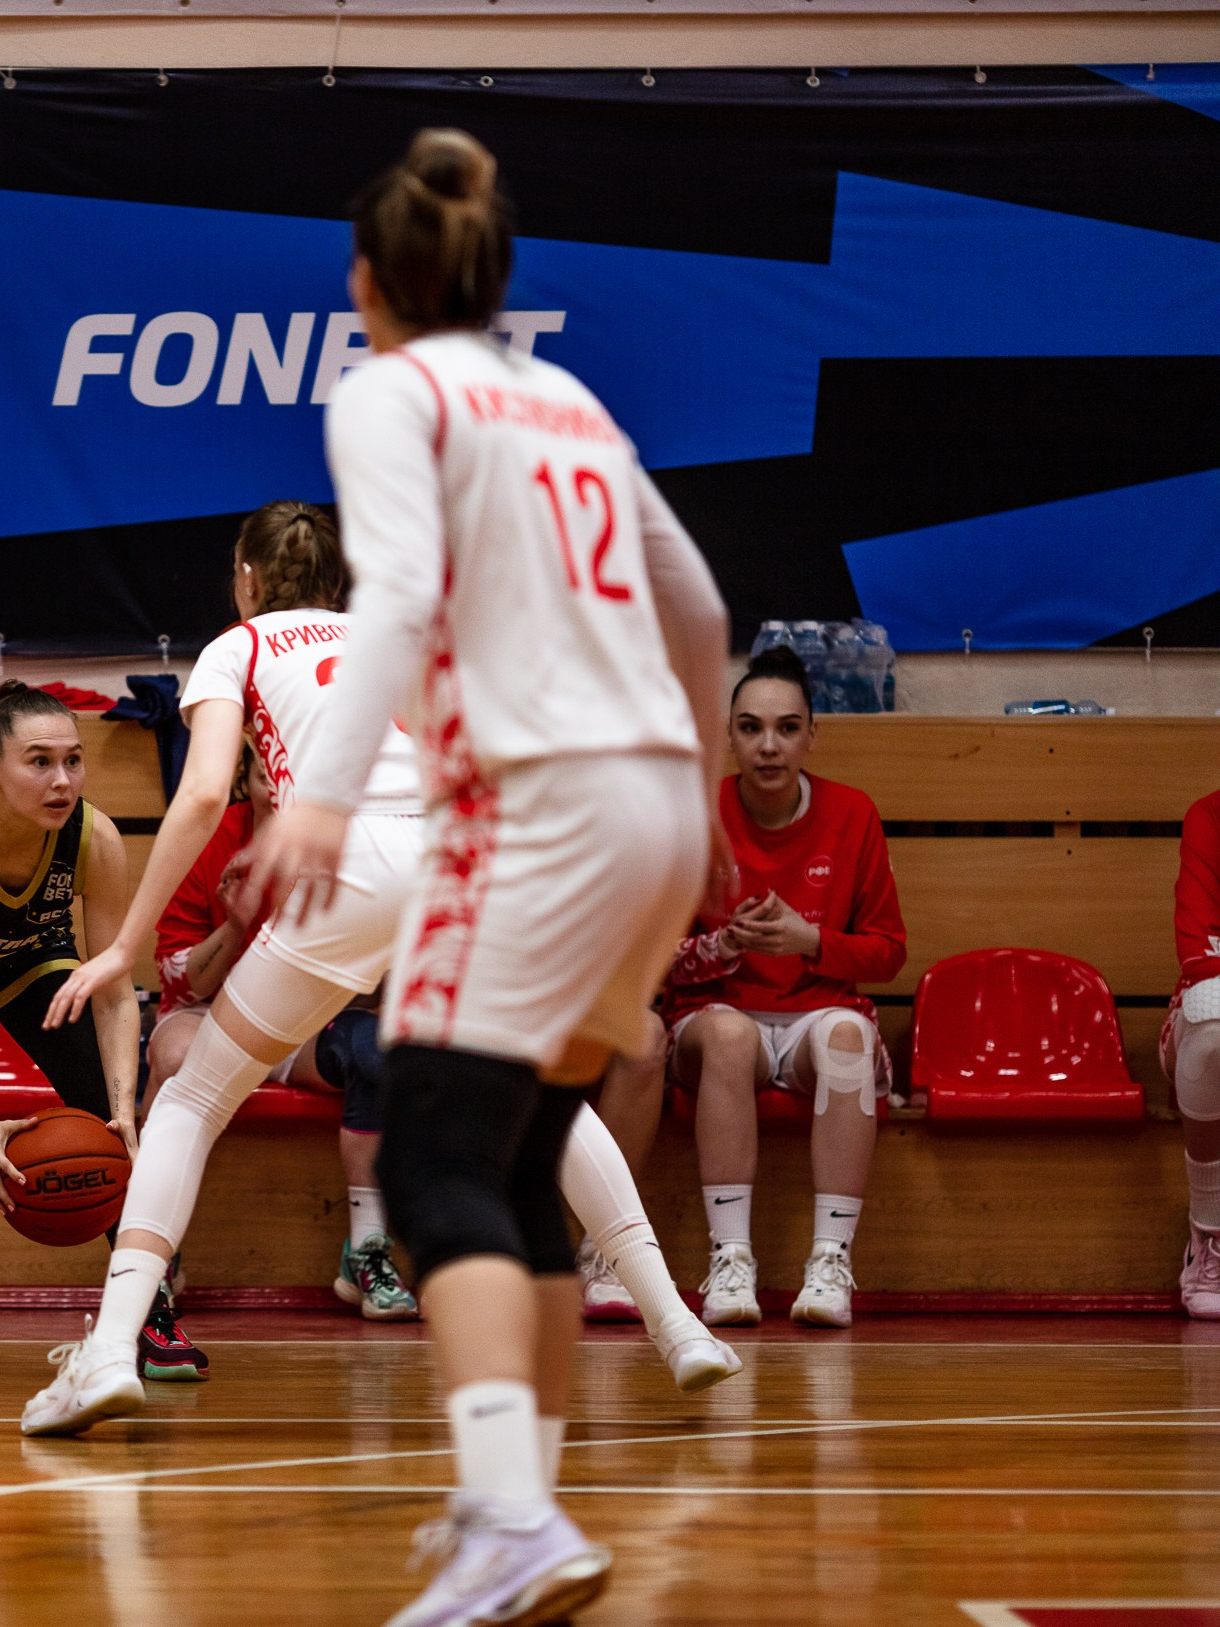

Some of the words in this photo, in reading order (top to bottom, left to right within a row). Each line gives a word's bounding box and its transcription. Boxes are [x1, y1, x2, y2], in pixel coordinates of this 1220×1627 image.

[52, 310, 567, 407] FONT
[532, 457, 634, 604] 12
[265, 623, 350, 658] КРИВО
[26, 1169, 116, 1195] JÖGEL
